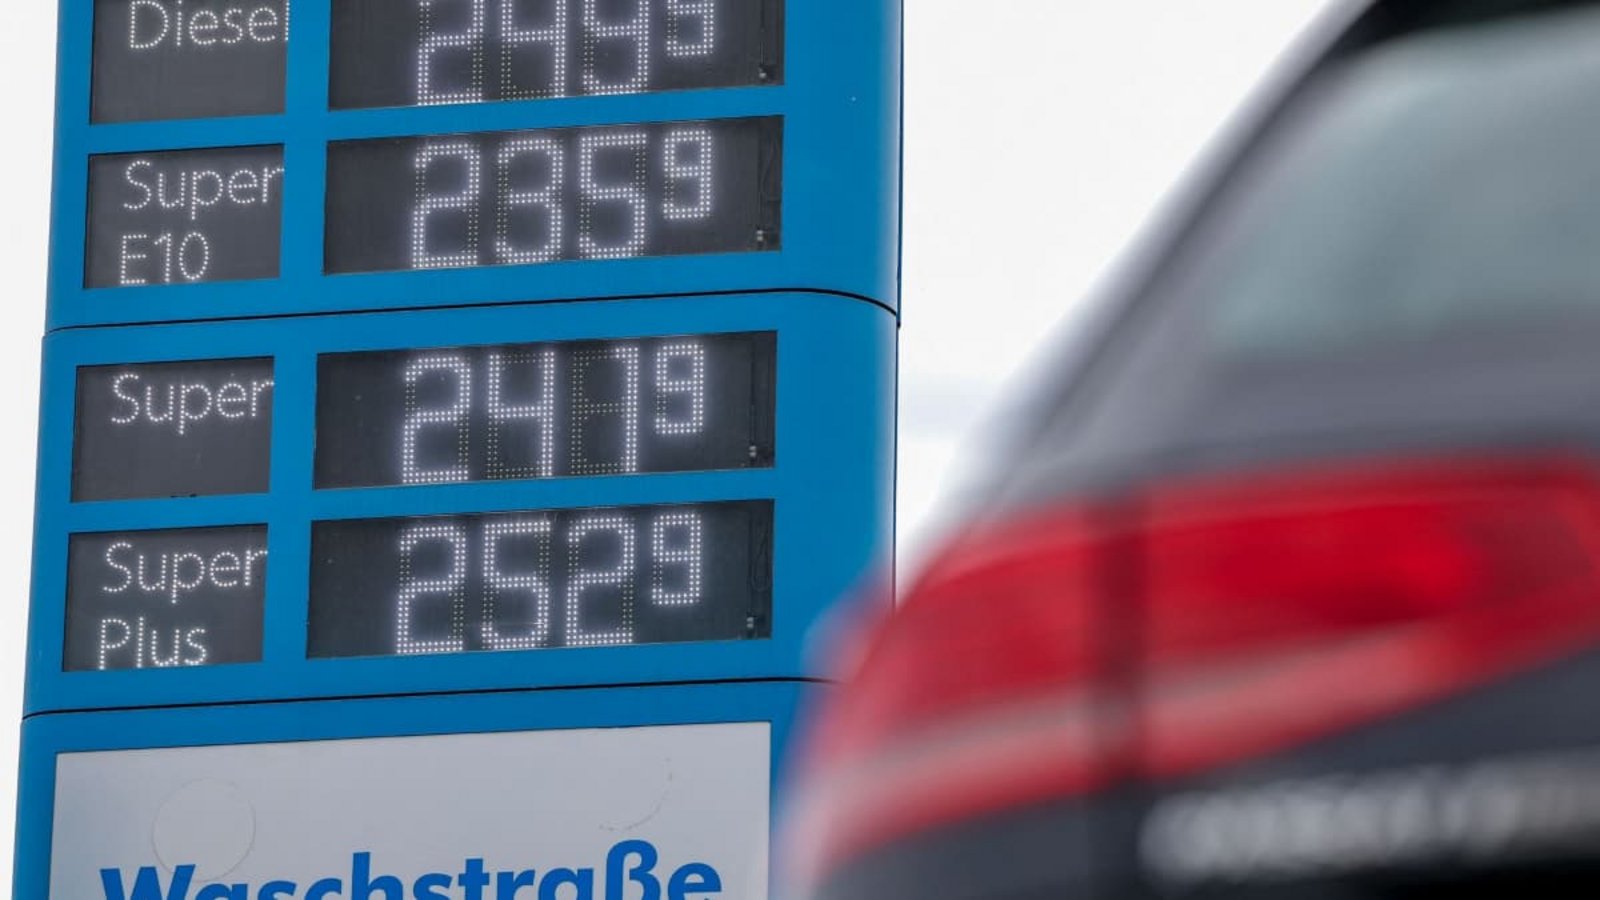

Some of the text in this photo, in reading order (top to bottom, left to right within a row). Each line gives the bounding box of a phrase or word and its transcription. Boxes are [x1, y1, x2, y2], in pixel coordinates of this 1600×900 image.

[130, 0, 290, 49] Diesel
[122, 159, 285, 221] Super
[119, 231, 210, 286] E10
[110, 373, 275, 435] Super
[102, 541, 269, 604] Super
[98, 616, 209, 671] Plus
